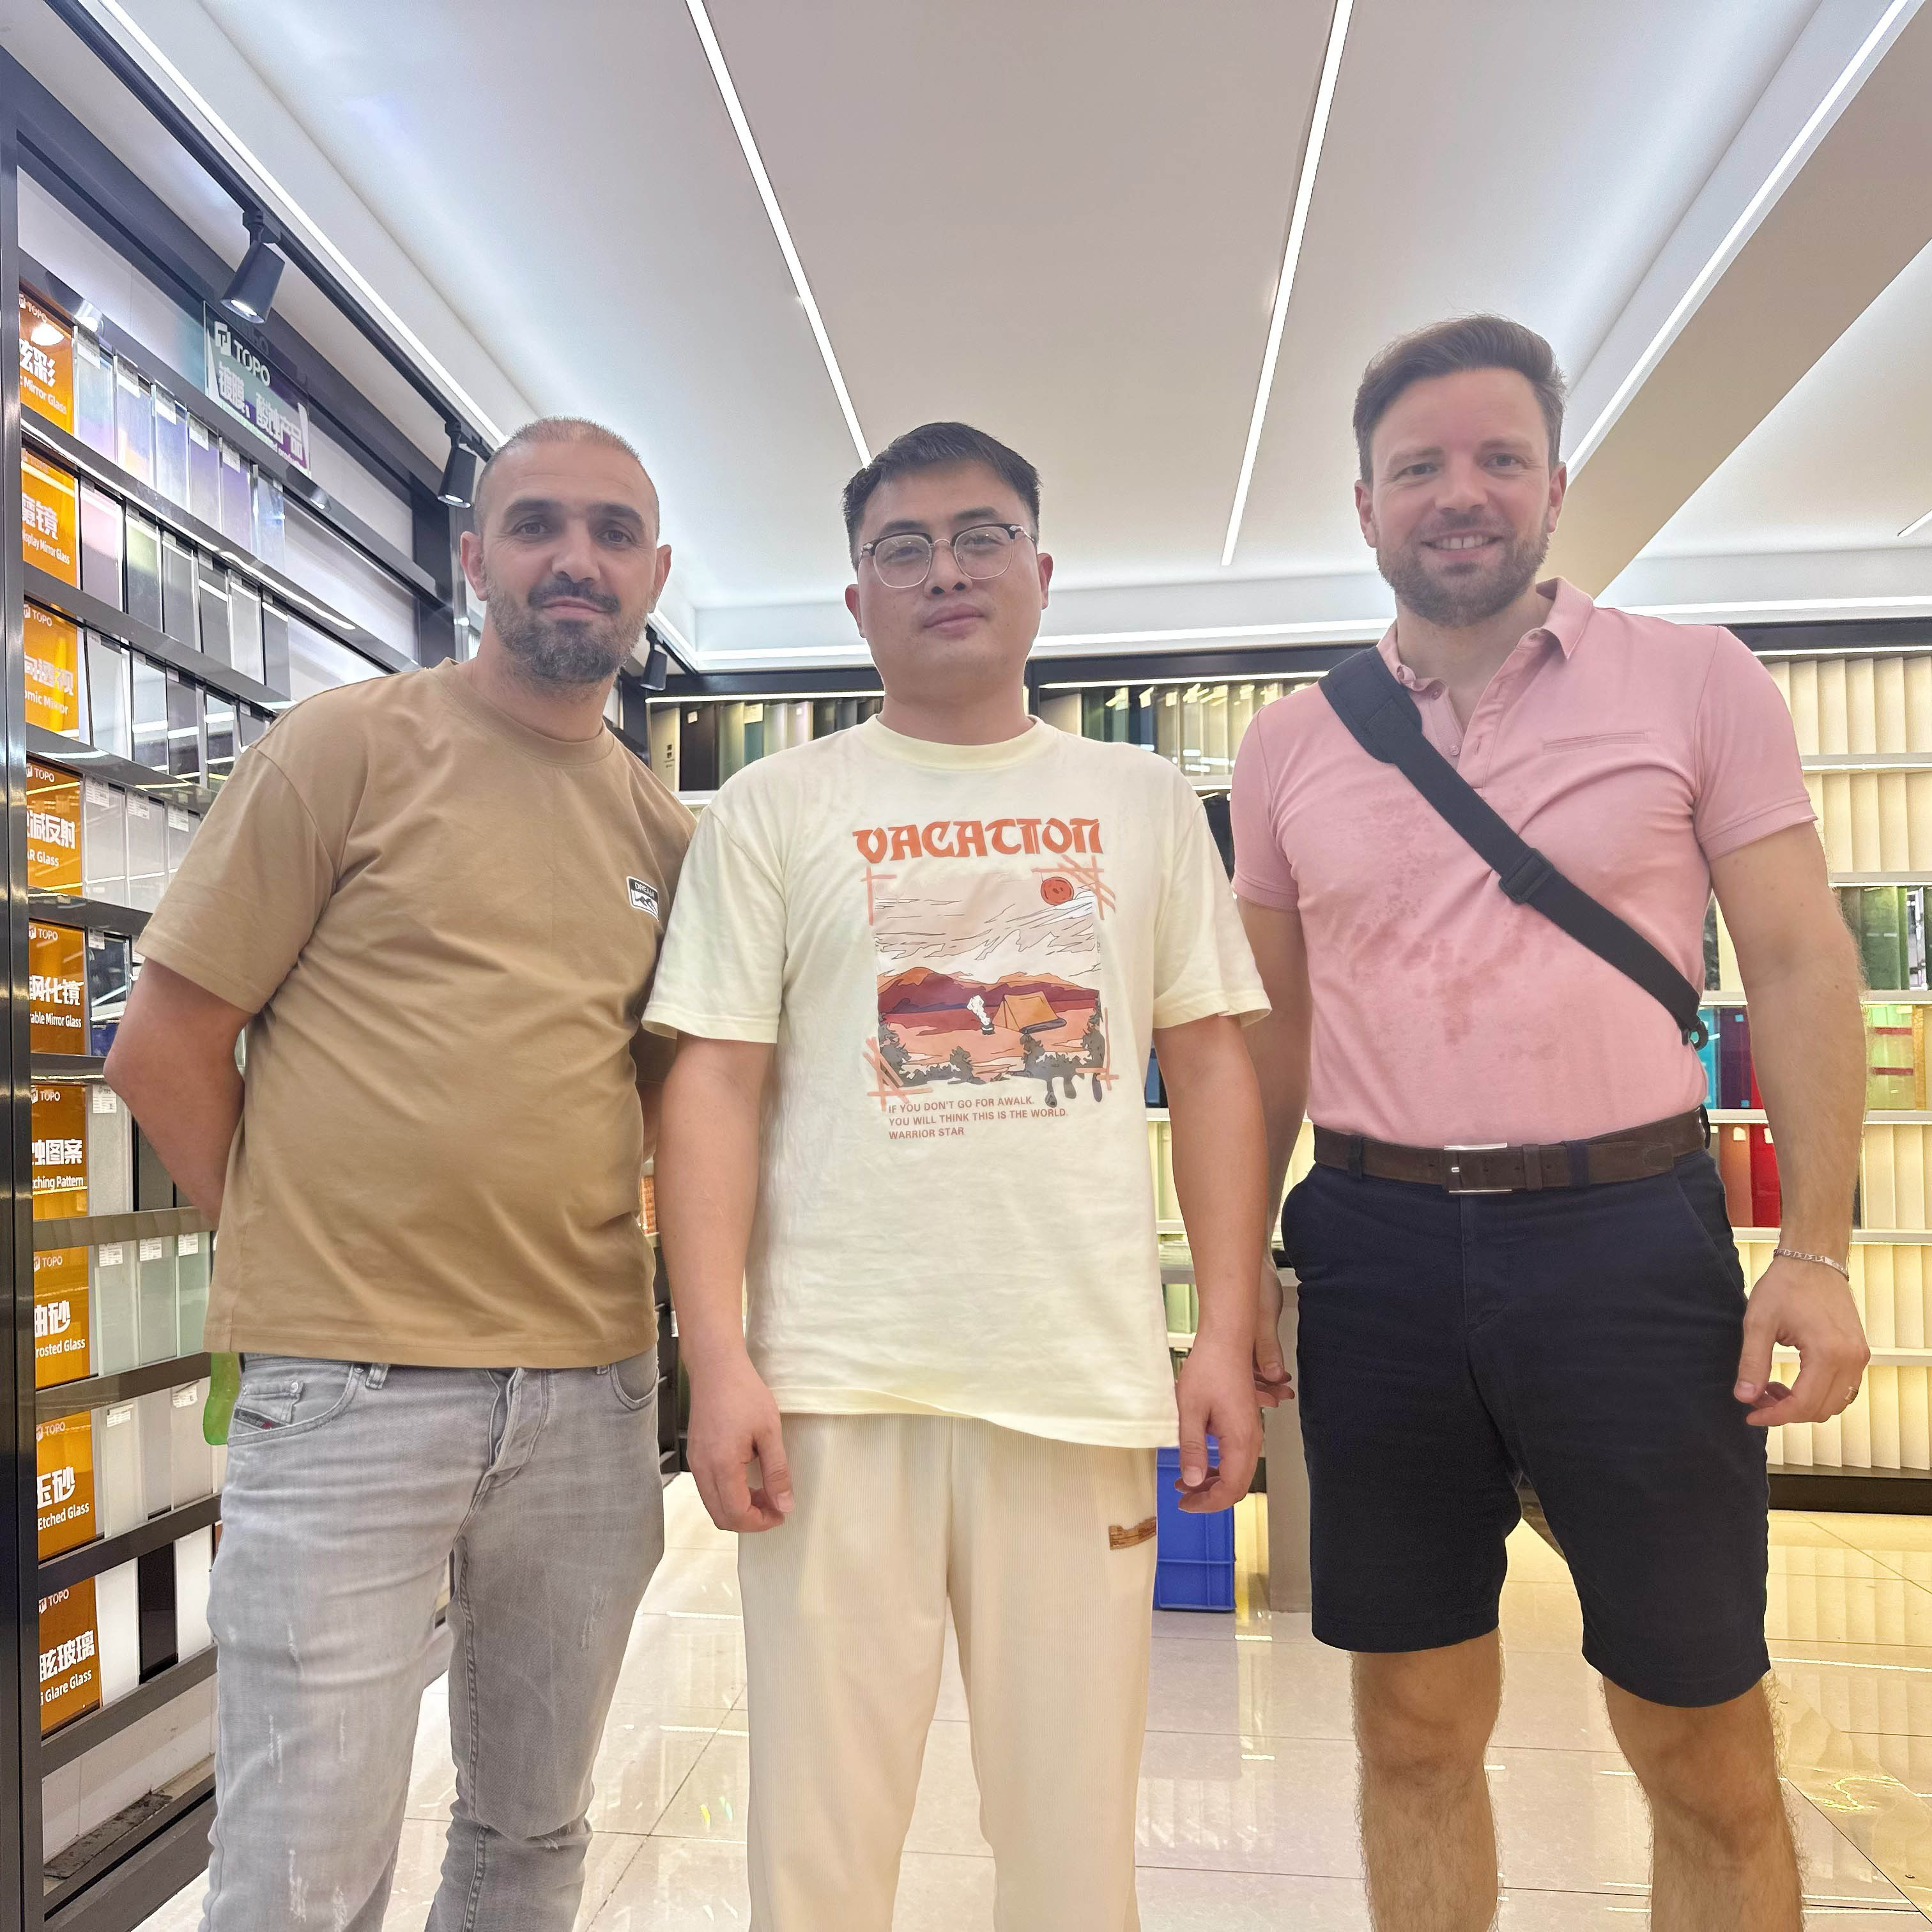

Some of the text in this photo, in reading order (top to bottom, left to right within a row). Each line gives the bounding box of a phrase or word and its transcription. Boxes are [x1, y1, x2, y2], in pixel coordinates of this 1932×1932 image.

[234, 340, 271, 387] TOPO
[24, 376, 46, 401] Mirror
[47, 393, 67, 415] Glass
[40, 539, 56, 556] Mirror
[56, 547, 70, 565] Glass
[32, 610, 52, 627] TOPO
[43, 695, 68, 716] Mirror
[34, 767, 55, 783] TOPO
[853, 817, 1104, 864] VACATION
[36, 850, 59, 867] Glass
[38, 928, 58, 940] TOPO
[29, 1012, 82, 1029] able Mirror Glass
[40, 1091, 61, 1101] TOPO
[889, 1105, 897, 1114] IF
[900, 1103, 921, 1113] YOU
[924, 1100, 954, 1111] DON'T
[958, 1100, 972, 1108] GO
[976, 1098, 994, 1107] FOR
[889, 1117, 910, 1126] YOU
[914, 1116, 937, 1125] WILL
[939, 1114, 969, 1123] THINK
[972, 1112, 994, 1121] THIS
[997, 1110, 1006, 1119] IS
[1009, 1109, 1028, 1118] THE
[889, 1126, 965, 1140] WARRIOR STAR
[56, 1176, 84, 1188] Pattern
[42, 1255, 63, 1268] TOPO
[63, 1338, 86, 1353] Glass
[44, 1421, 65, 1436] TOPO
[38, 1502, 89, 1531] Etched Glass
[47, 1588, 70, 1606] TOPO
[45, 1682, 68, 1703] Glare
[69, 1669, 92, 1688] Glass
